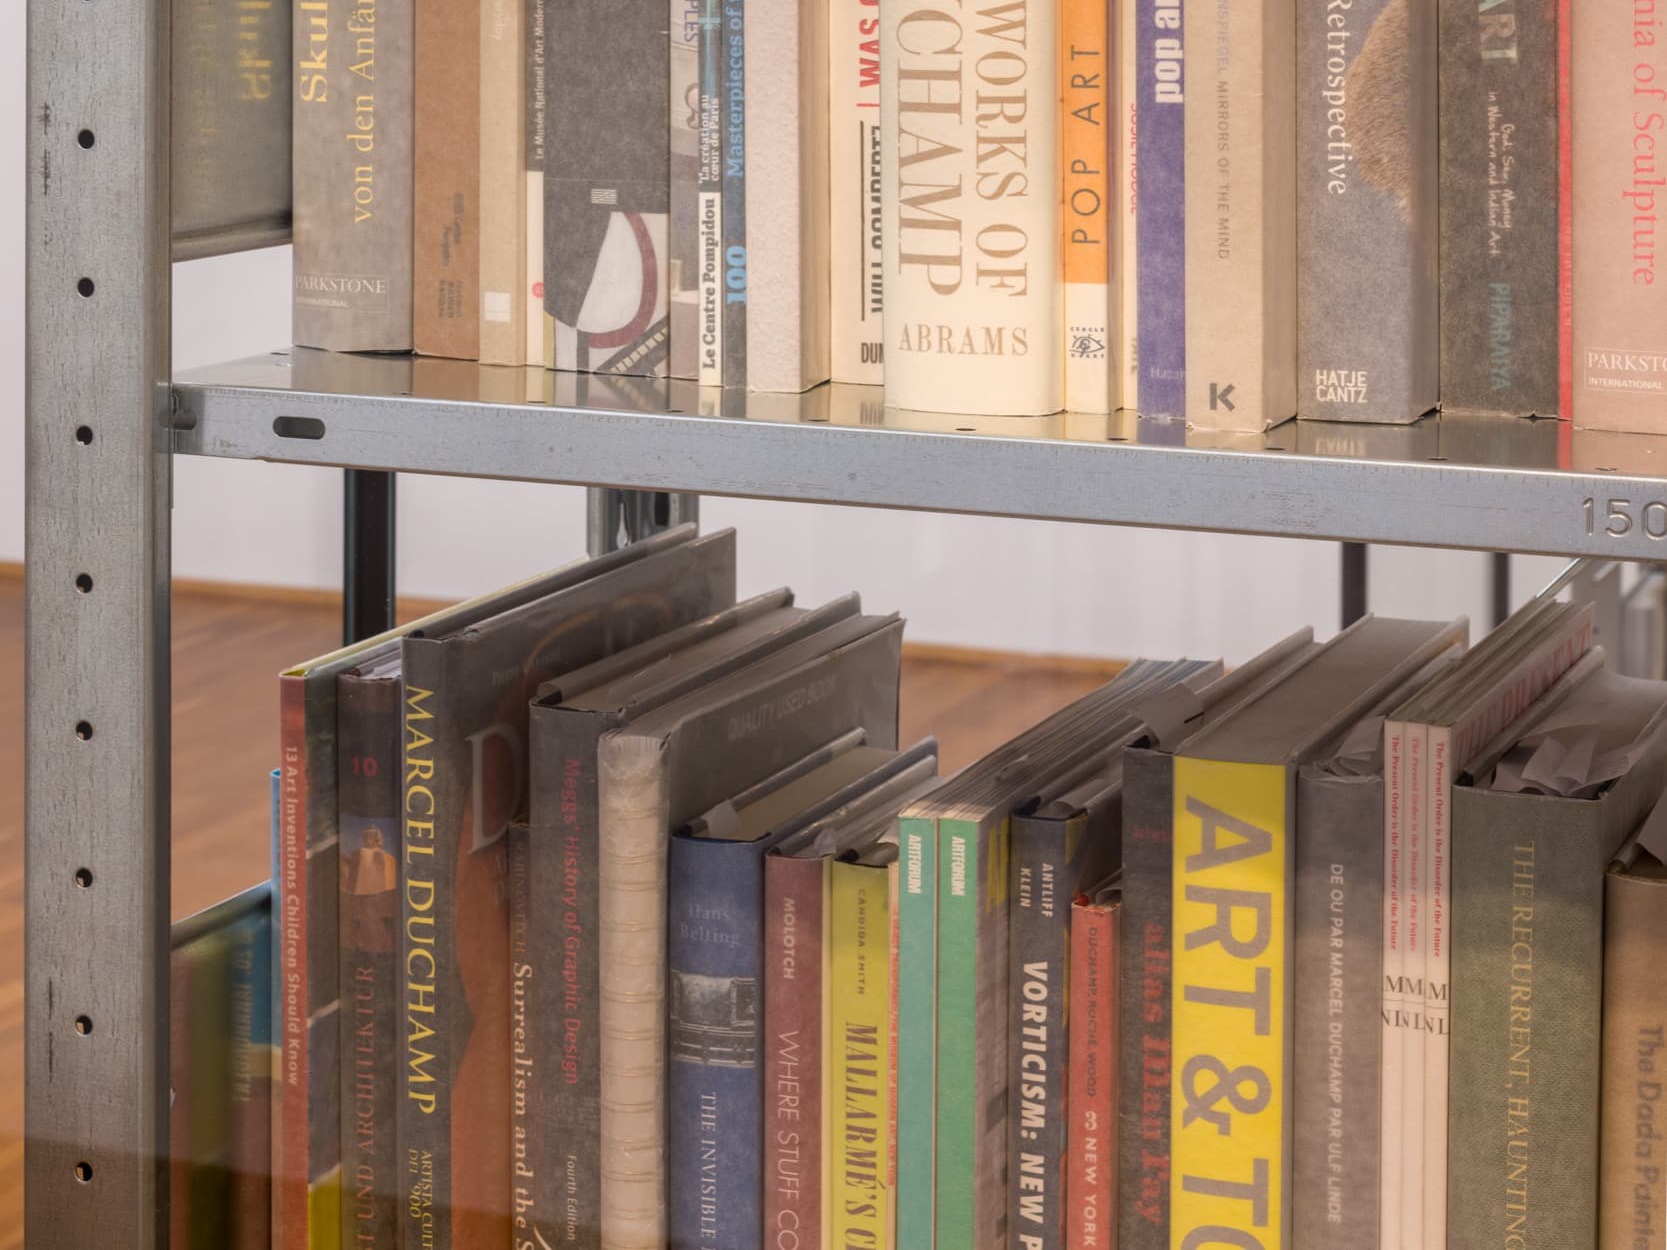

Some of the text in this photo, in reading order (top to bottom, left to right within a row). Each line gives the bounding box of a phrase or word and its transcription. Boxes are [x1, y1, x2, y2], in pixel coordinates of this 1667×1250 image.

[725, 3, 742, 31] of
[1154, 38, 1183, 104] pop
[1633, 62, 1667, 100] of
[346, 94, 376, 152] den
[726, 35, 745, 178] Masterpieces
[1216, 80, 1230, 151] MIRRORS
[1069, 44, 1101, 245] POP ART
[1217, 157, 1231, 175] OF
[353, 164, 373, 223] von
[1217, 182, 1231, 211] THE
[1621, 111, 1667, 286] Sculpture
[975, 223, 1028, 298] OF
[1216, 216, 1231, 260] MIND
[295, 276, 386, 295] PARKSTONE
[701, 197, 718, 370] Le Centre Pompidou
[726, 245, 747, 305] 100
[897, 322, 1030, 358] ABRAMS
[1208, 382, 1236, 412] K
[1316, 369, 1367, 388] HATJE
[1316, 387, 1368, 404] CANTZ
[1588, 377, 1663, 390] INTERNATIONAL
[1583, 497, 1667, 541] 150
[1434, 757, 1444, 797] Present
[1435, 742, 1445, 755] The
[1434, 798, 1444, 823] Order
[907, 834, 922, 895] ARTFORUM
[951, 836, 966, 897] ARTFORUM
[1434, 837, 1444, 853] the
[405, 684, 437, 1115] MARCEL DUCHAMP
[1019, 867, 1032, 908] KLEIN
[1040, 862, 1053, 918] ANTLIFF
[1433, 855, 1444, 897] Disorder
[285, 746, 301, 1087] 13 Art Inventions Children Should Know
[783, 898, 797, 980] MOLOTCH
[857, 888, 866, 995] CANDIDA SMITH
[1183, 794, 1273, 1037] ART
[1432, 926, 1443, 958] Future
[1433, 908, 1443, 924] the
[561, 836, 582, 1085] History Graphic Design
[1505, 839, 1536, 1088] THE RECURRENT,
[355, 965, 376, 1151] ARCHITEKTUR
[1327, 864, 1344, 1224] DE OU PAR MARCEL DUCHAMP PAR ULF LINDE
[512, 961, 535, 1229] Surrealism and the
[776, 1030, 799, 1201] WHERE STUFF
[845, 1022, 886, 1219] MALLARMÉ'S
[1018, 960, 1048, 1224] VORTICISM: NEW
[1181, 1053, 1272, 1137] &
[699, 1091, 717, 1240] THE INVISIBLE
[566, 1154, 578, 1241] Fourth Edition
